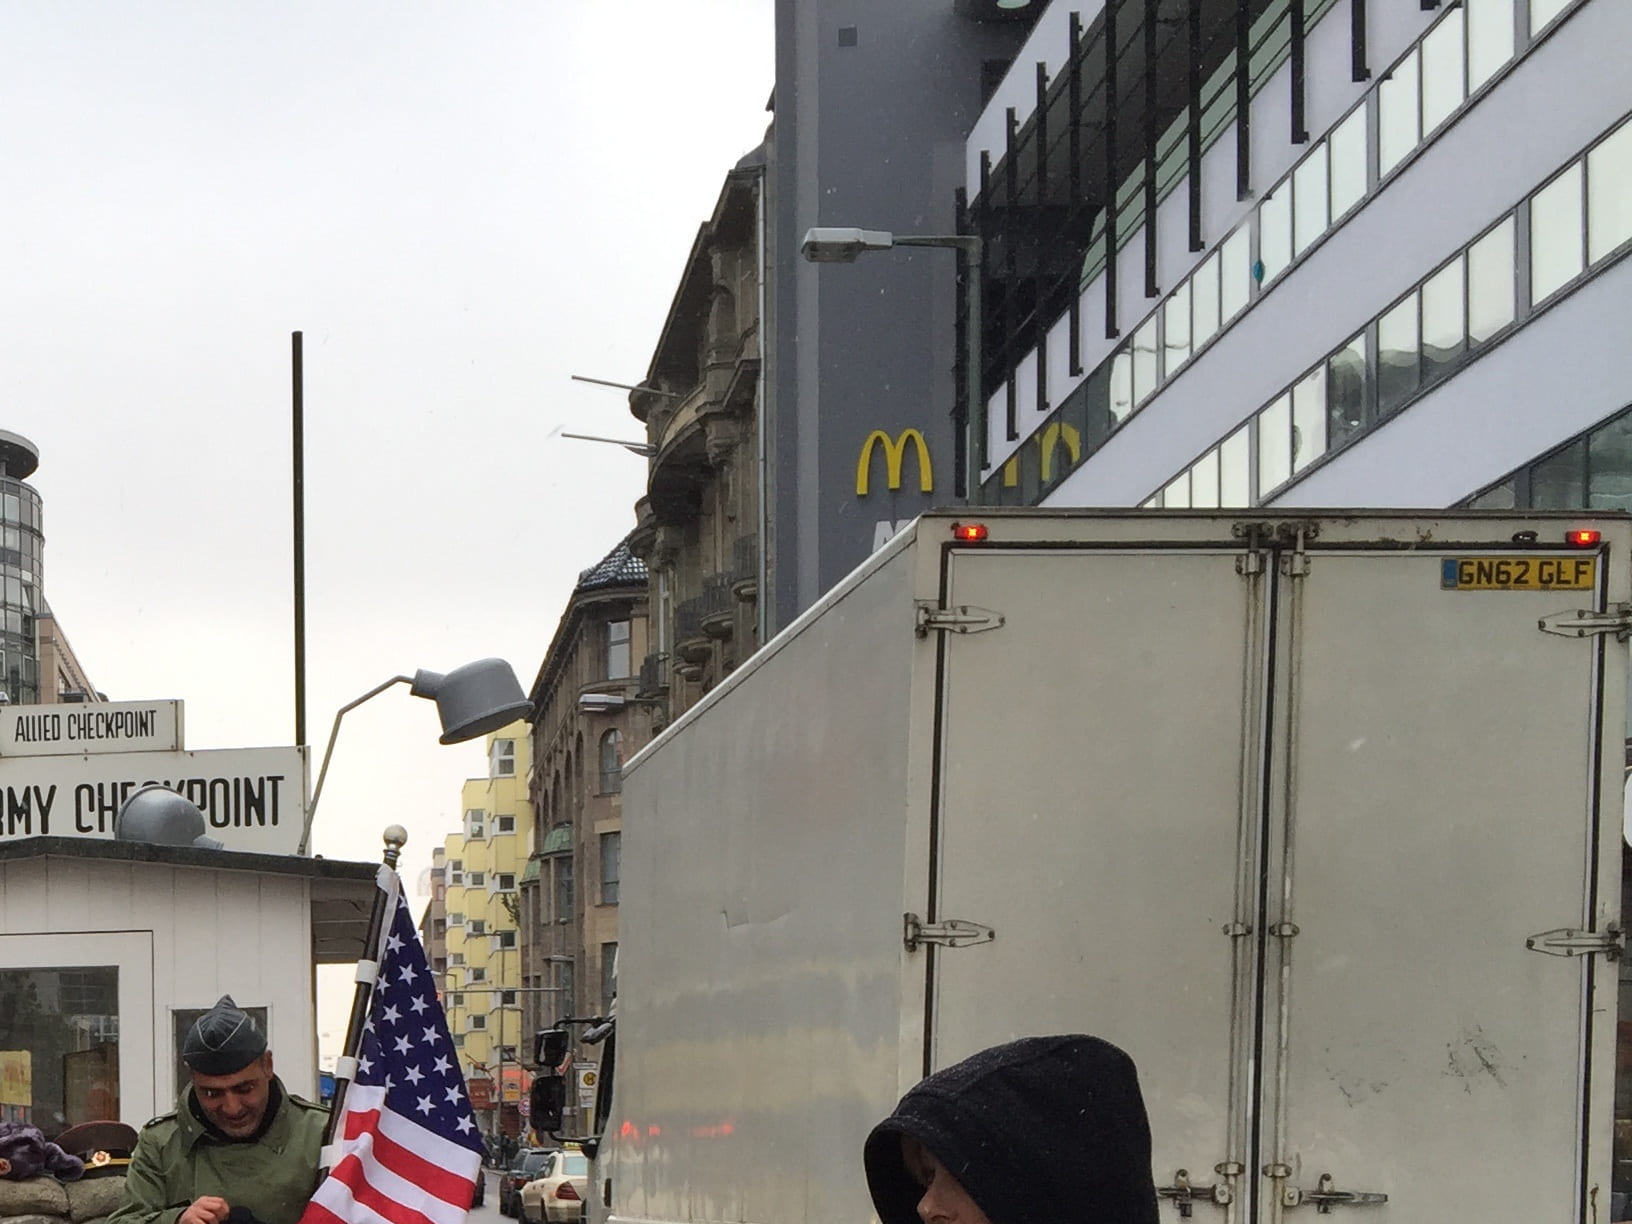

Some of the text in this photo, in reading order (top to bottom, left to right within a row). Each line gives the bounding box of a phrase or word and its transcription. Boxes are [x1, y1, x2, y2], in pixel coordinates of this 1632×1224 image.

[1459, 560, 1591, 585] GN62 GLF
[14, 710, 157, 742] ALLIED CHECKPOINT
